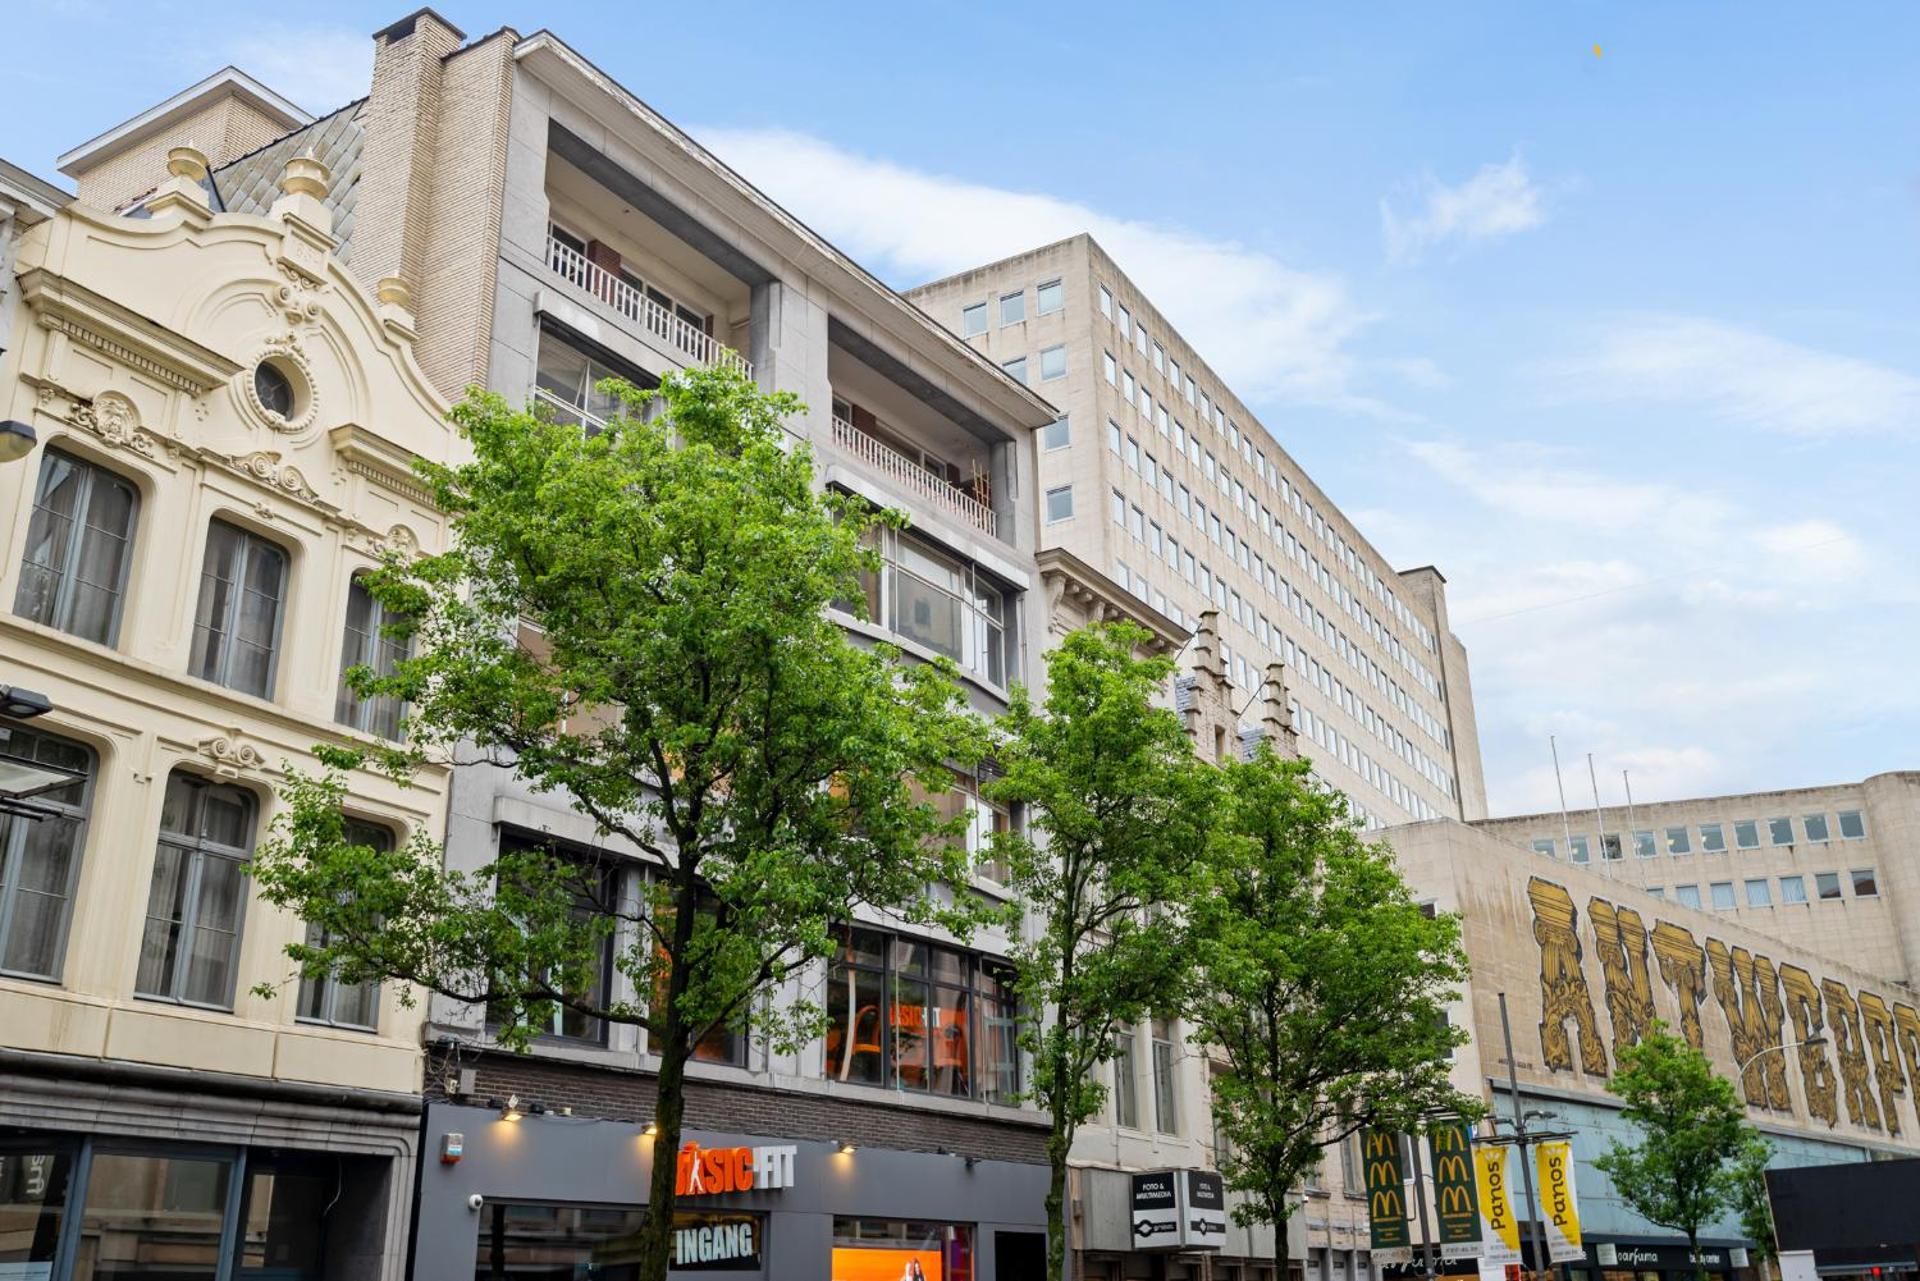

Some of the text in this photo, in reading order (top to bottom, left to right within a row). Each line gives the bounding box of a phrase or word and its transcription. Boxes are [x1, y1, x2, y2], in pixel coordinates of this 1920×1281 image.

[1142, 1183, 1158, 1191] FOTO
[1488, 1161, 1506, 1230] Panos
[1549, 1156, 1567, 1227] Panos
[676, 1222, 753, 1266] INGANG
